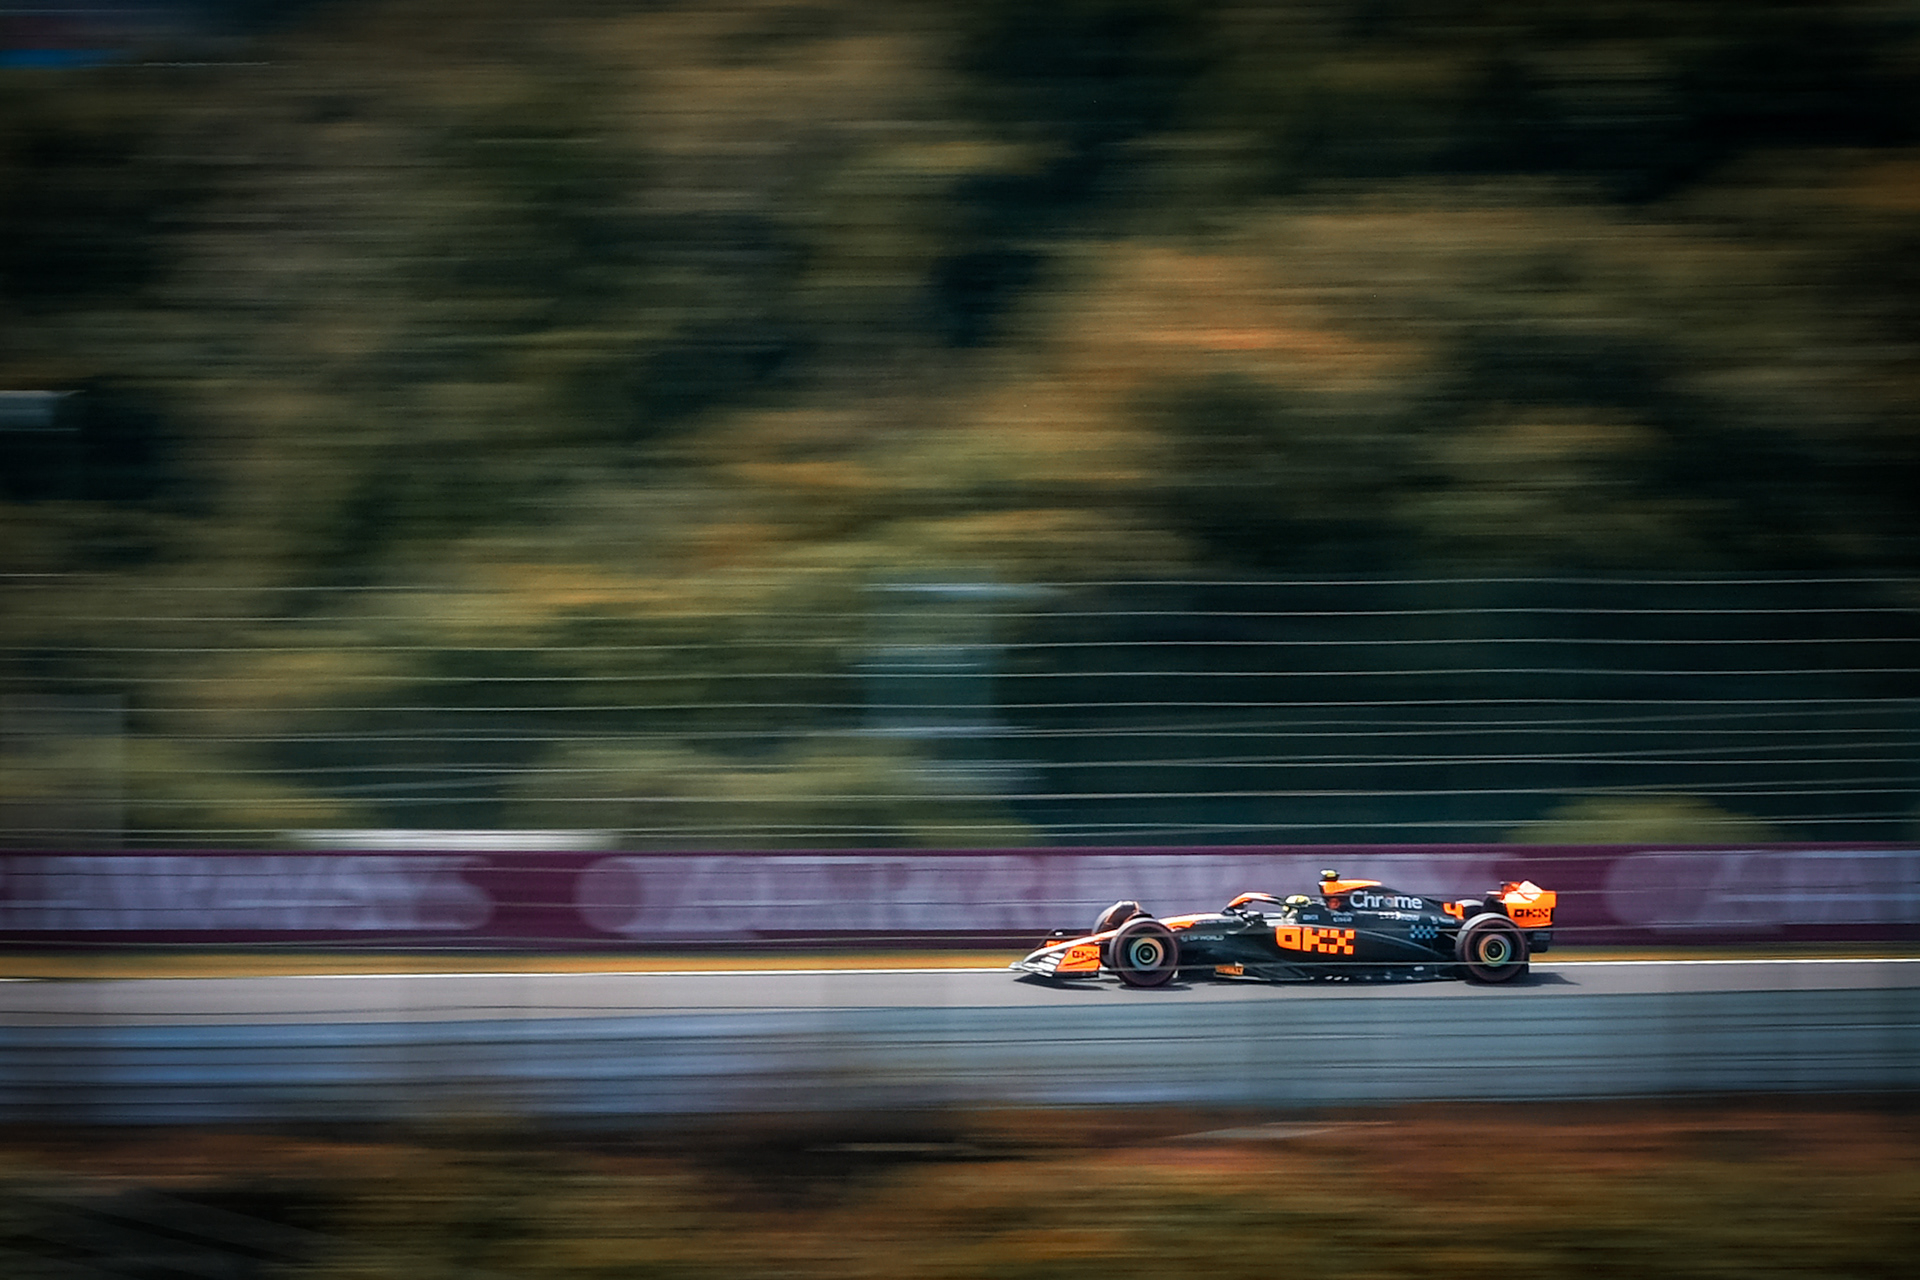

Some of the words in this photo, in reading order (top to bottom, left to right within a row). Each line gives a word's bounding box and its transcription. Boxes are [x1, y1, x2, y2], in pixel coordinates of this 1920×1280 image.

[1350, 890, 1423, 909] Chrome
[1443, 902, 1464, 920] 4
[1275, 926, 1355, 955] OKX
